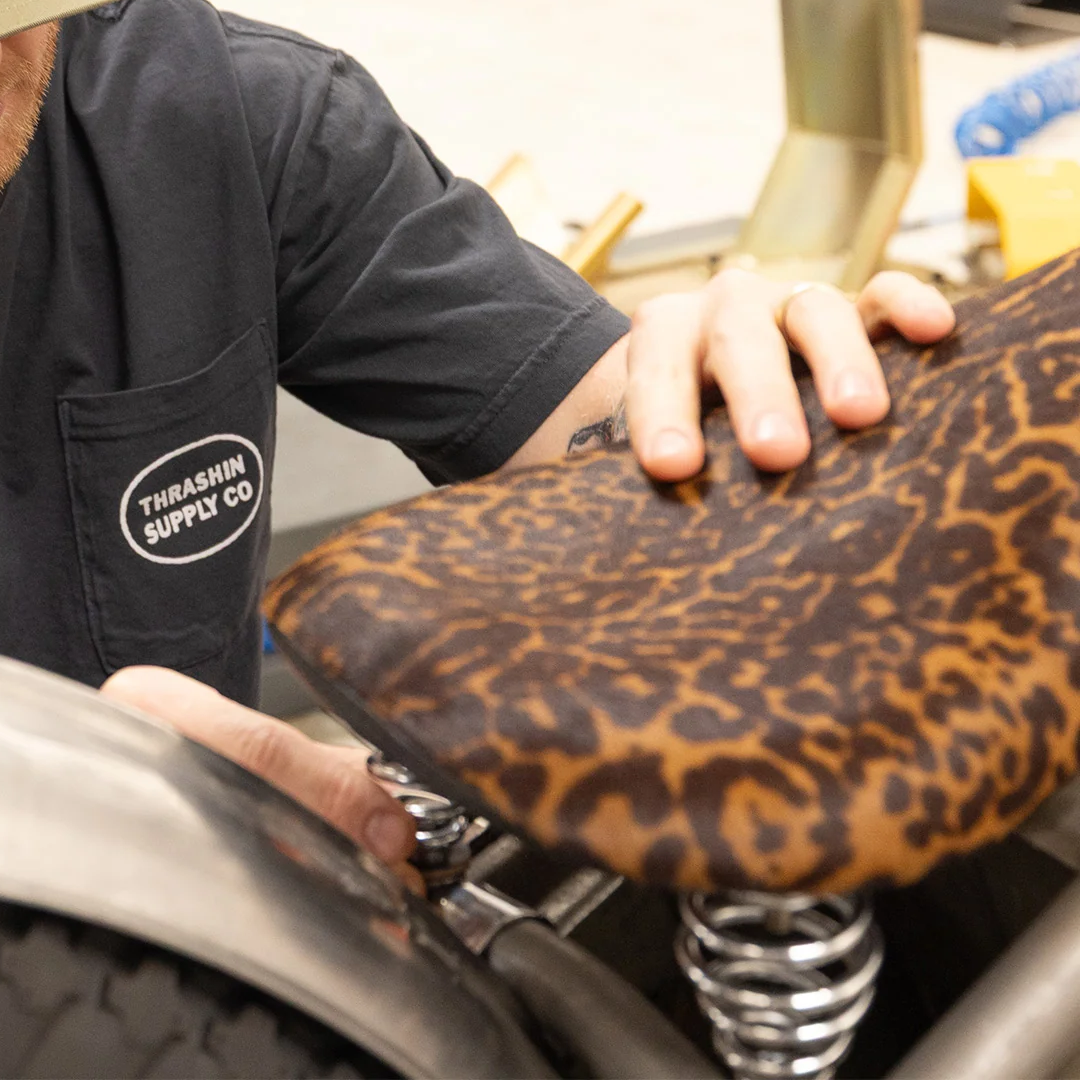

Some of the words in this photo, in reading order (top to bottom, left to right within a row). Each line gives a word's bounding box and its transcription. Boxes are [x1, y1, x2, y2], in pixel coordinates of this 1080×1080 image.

[138, 454, 246, 516] THRASHIN
[144, 493, 218, 545] SUPPLY
[223, 480, 253, 507] CO
